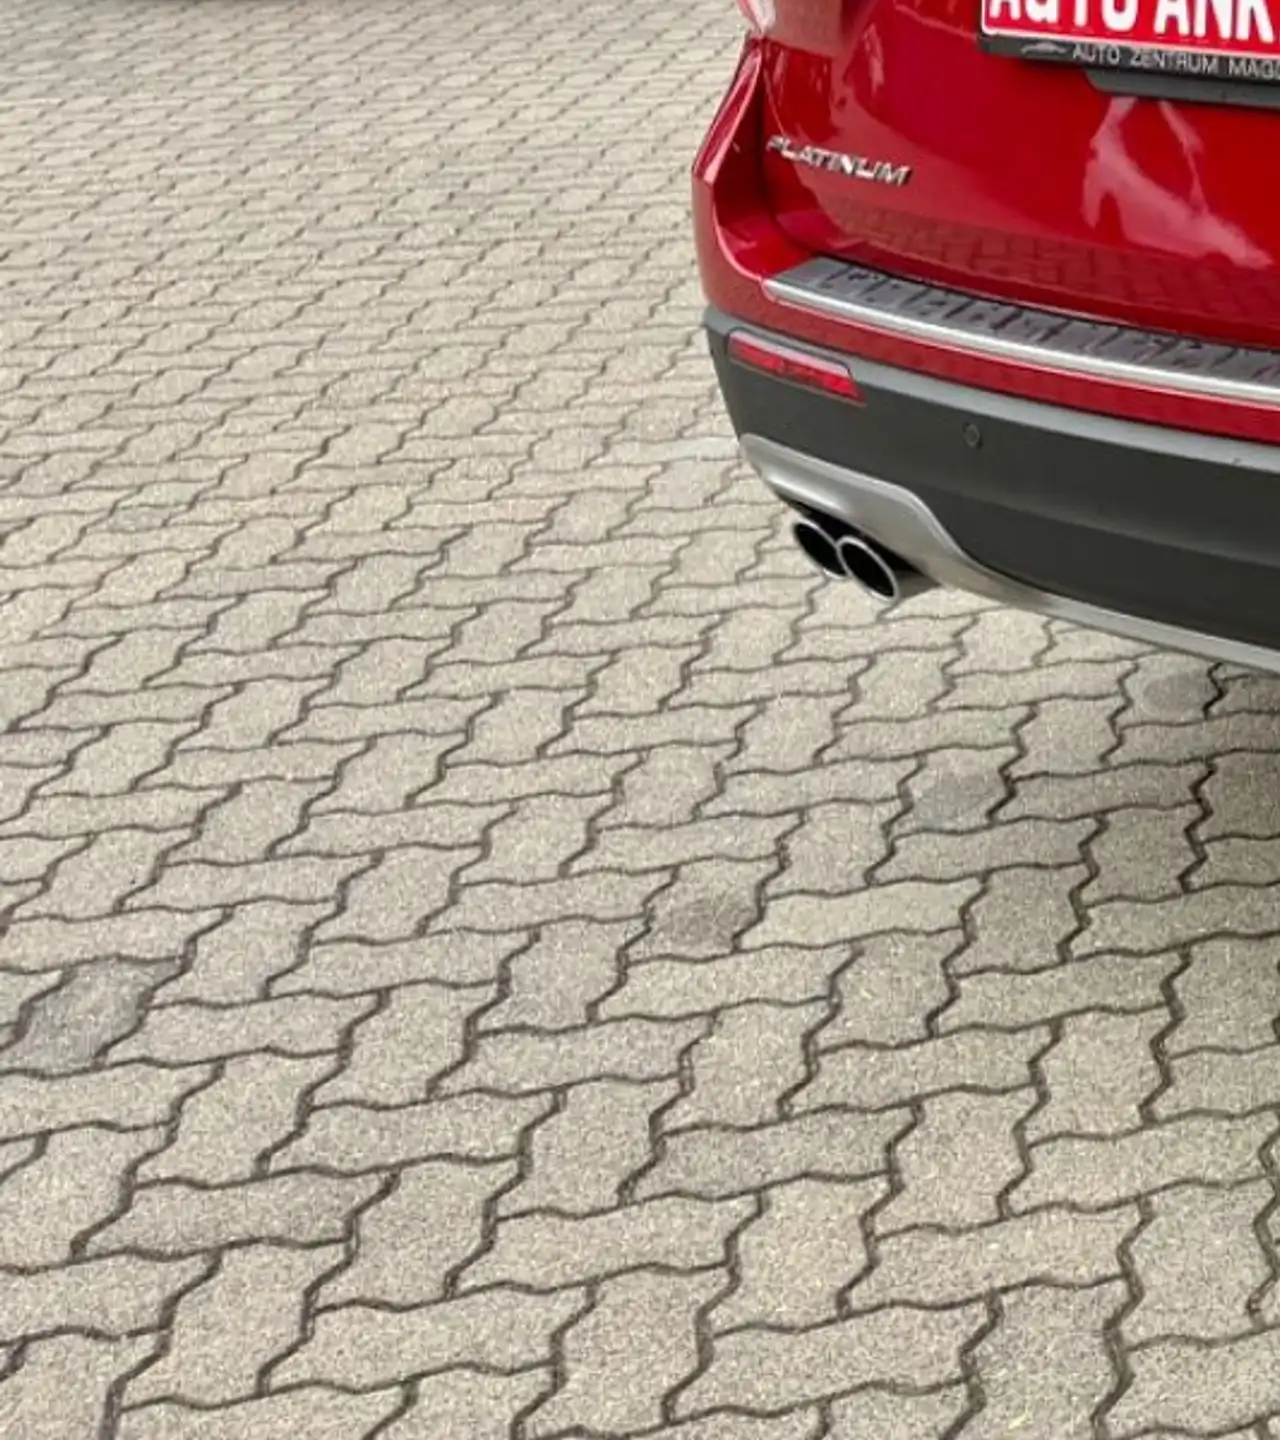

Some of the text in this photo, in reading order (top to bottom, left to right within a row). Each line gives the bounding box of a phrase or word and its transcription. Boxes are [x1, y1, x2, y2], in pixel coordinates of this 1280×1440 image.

[1072, 44, 1120, 63] AUTO
[1130, 51, 1220, 75] ZENTRUM
[766, 134, 912, 187] PLATINUM
